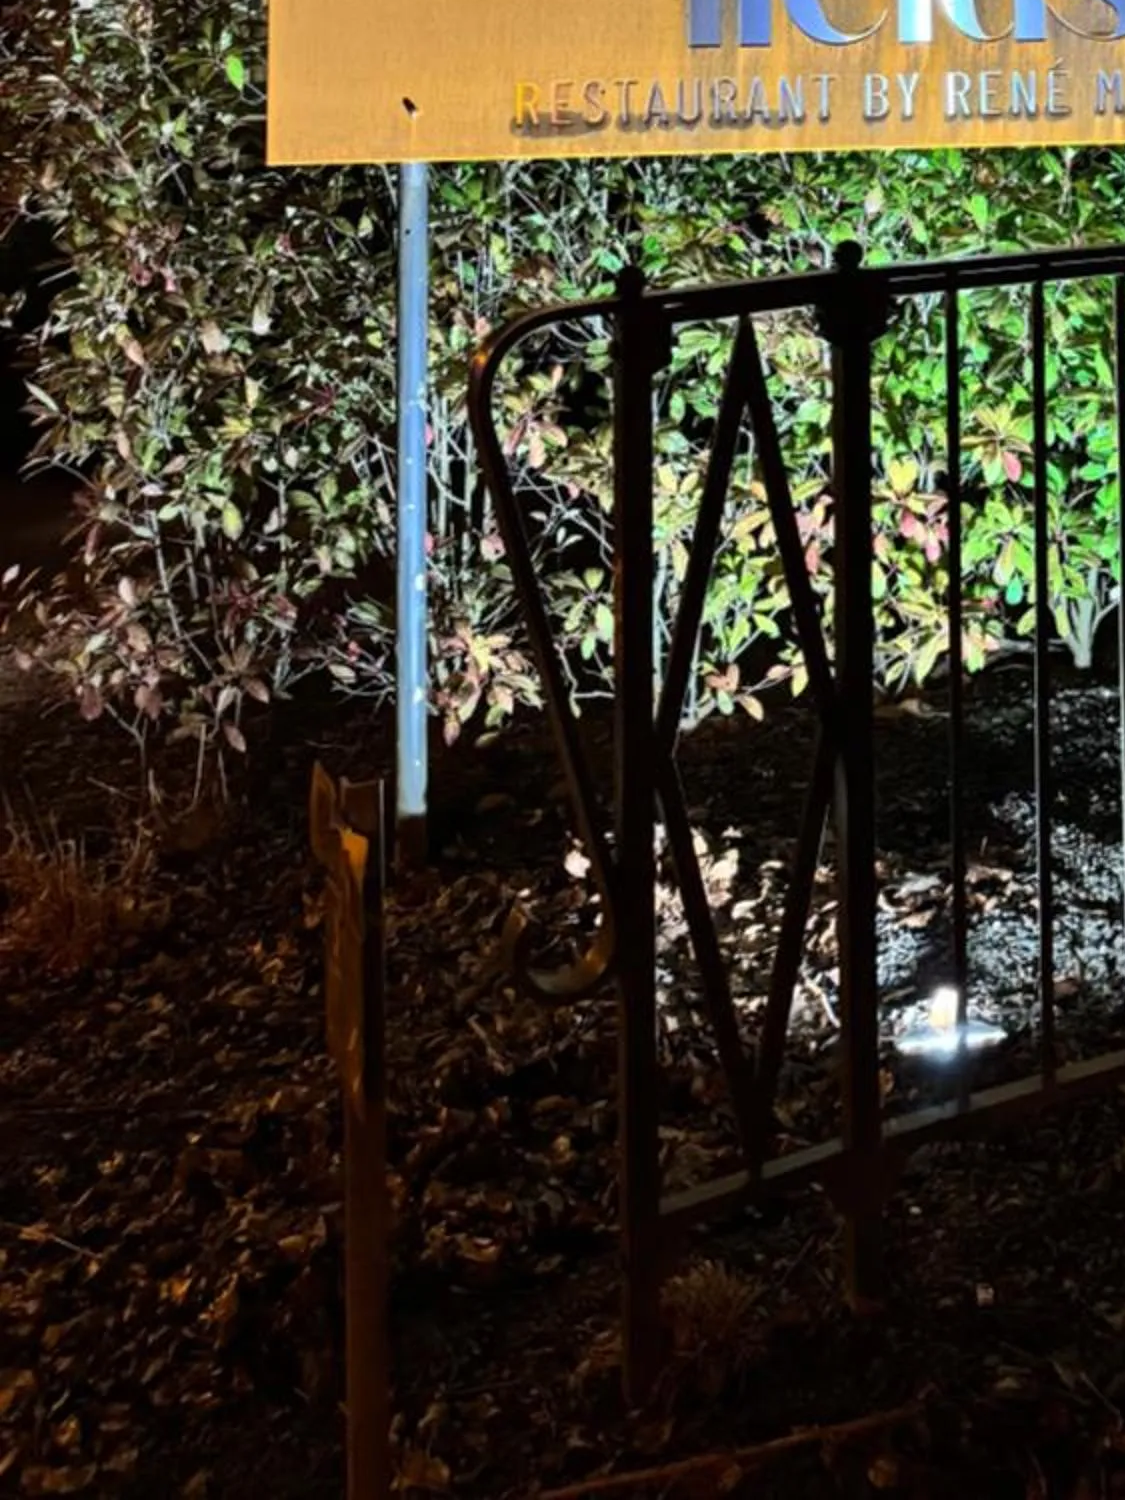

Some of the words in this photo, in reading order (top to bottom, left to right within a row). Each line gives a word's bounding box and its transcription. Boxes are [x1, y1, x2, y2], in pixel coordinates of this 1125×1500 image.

[513, 75, 836, 130] RESTAURANT
[863, 71, 923, 121] BY
[945, 57, 1071, 121] RENÉ
